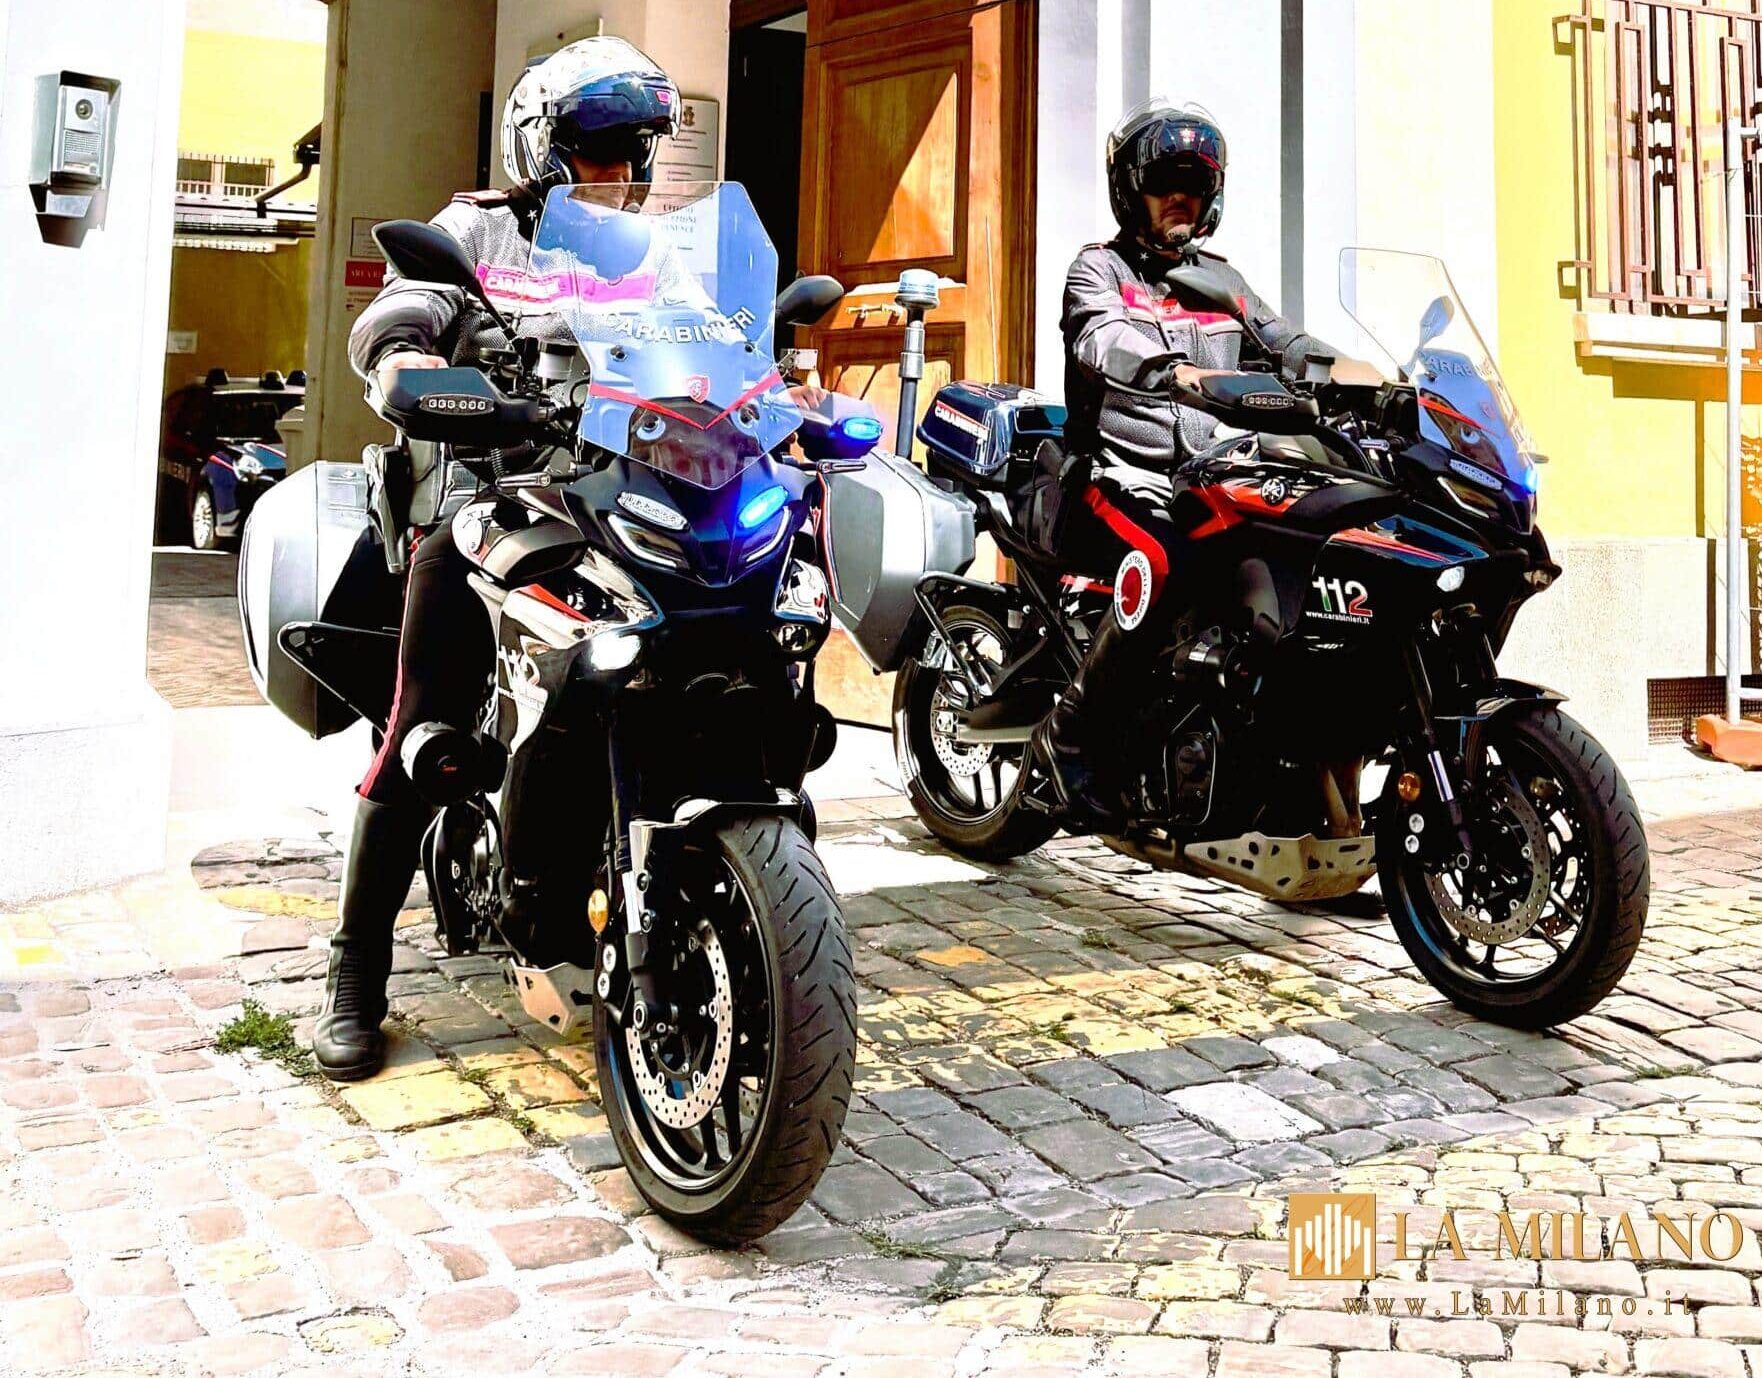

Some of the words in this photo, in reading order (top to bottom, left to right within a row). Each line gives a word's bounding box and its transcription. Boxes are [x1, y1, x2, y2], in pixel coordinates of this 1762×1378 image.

[605, 306, 756, 344] CARABINIERI
[1311, 576, 1373, 618] 112
[1304, 610, 1370, 625] www.carabinieri.it
